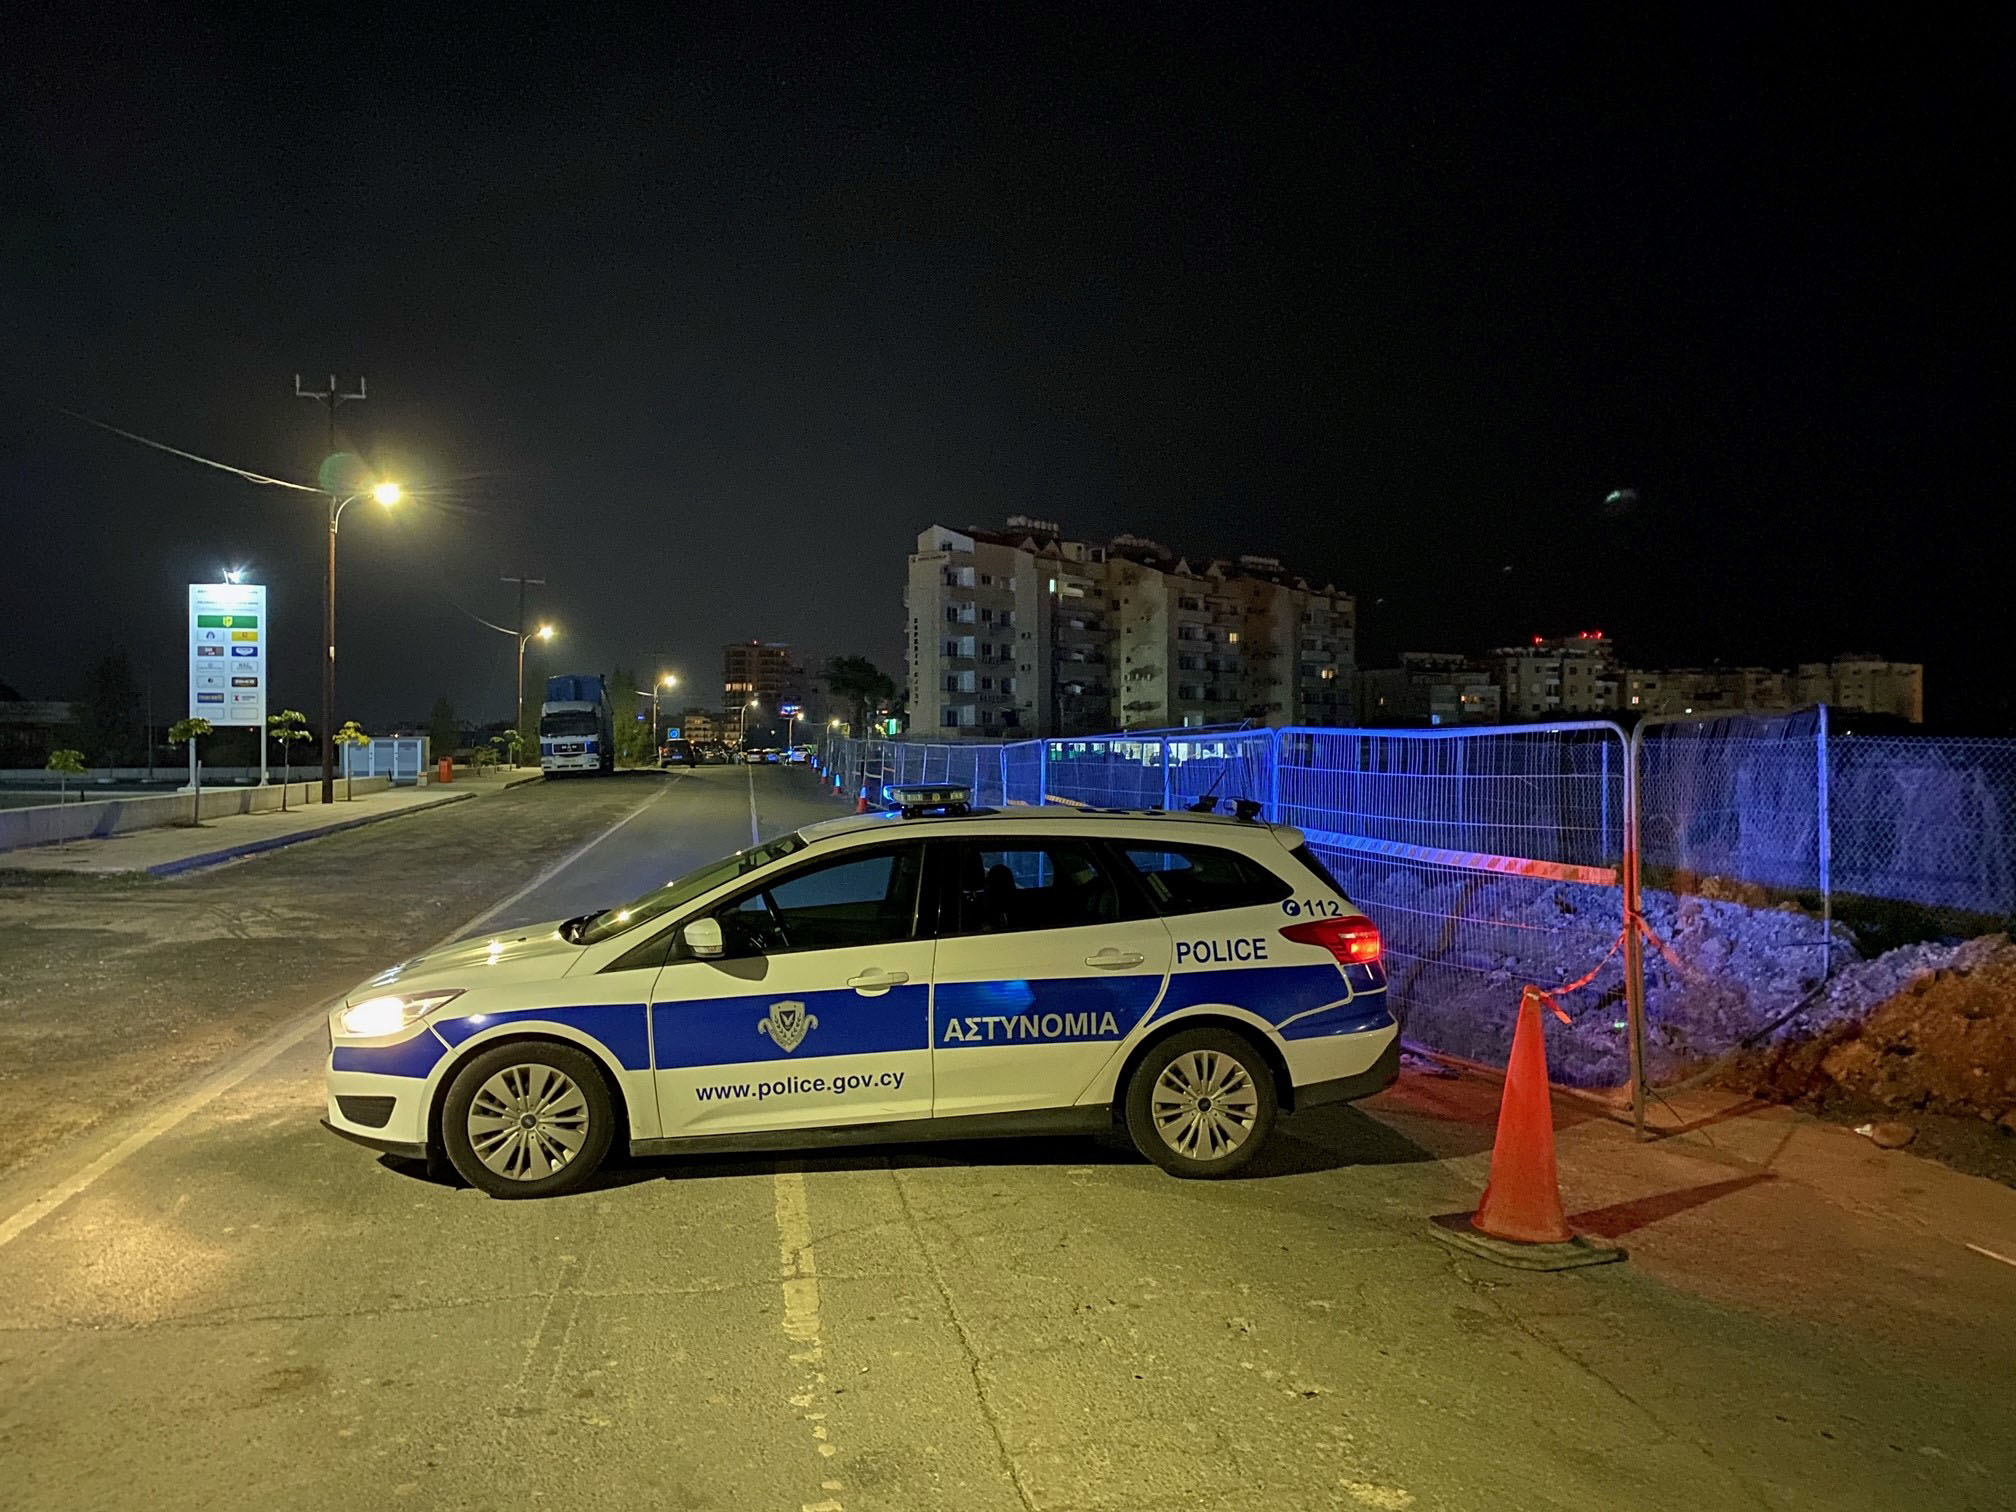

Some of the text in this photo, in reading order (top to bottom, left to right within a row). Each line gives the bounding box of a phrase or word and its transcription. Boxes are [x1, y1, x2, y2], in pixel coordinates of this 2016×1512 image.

[1303, 900, 1343, 917] 112
[1176, 938, 1269, 964] POLICE
[943, 1011, 1120, 1043] ΑΣΤΥΝΟΜΙΑ
[695, 1070, 906, 1101] www.police.gov.cy
